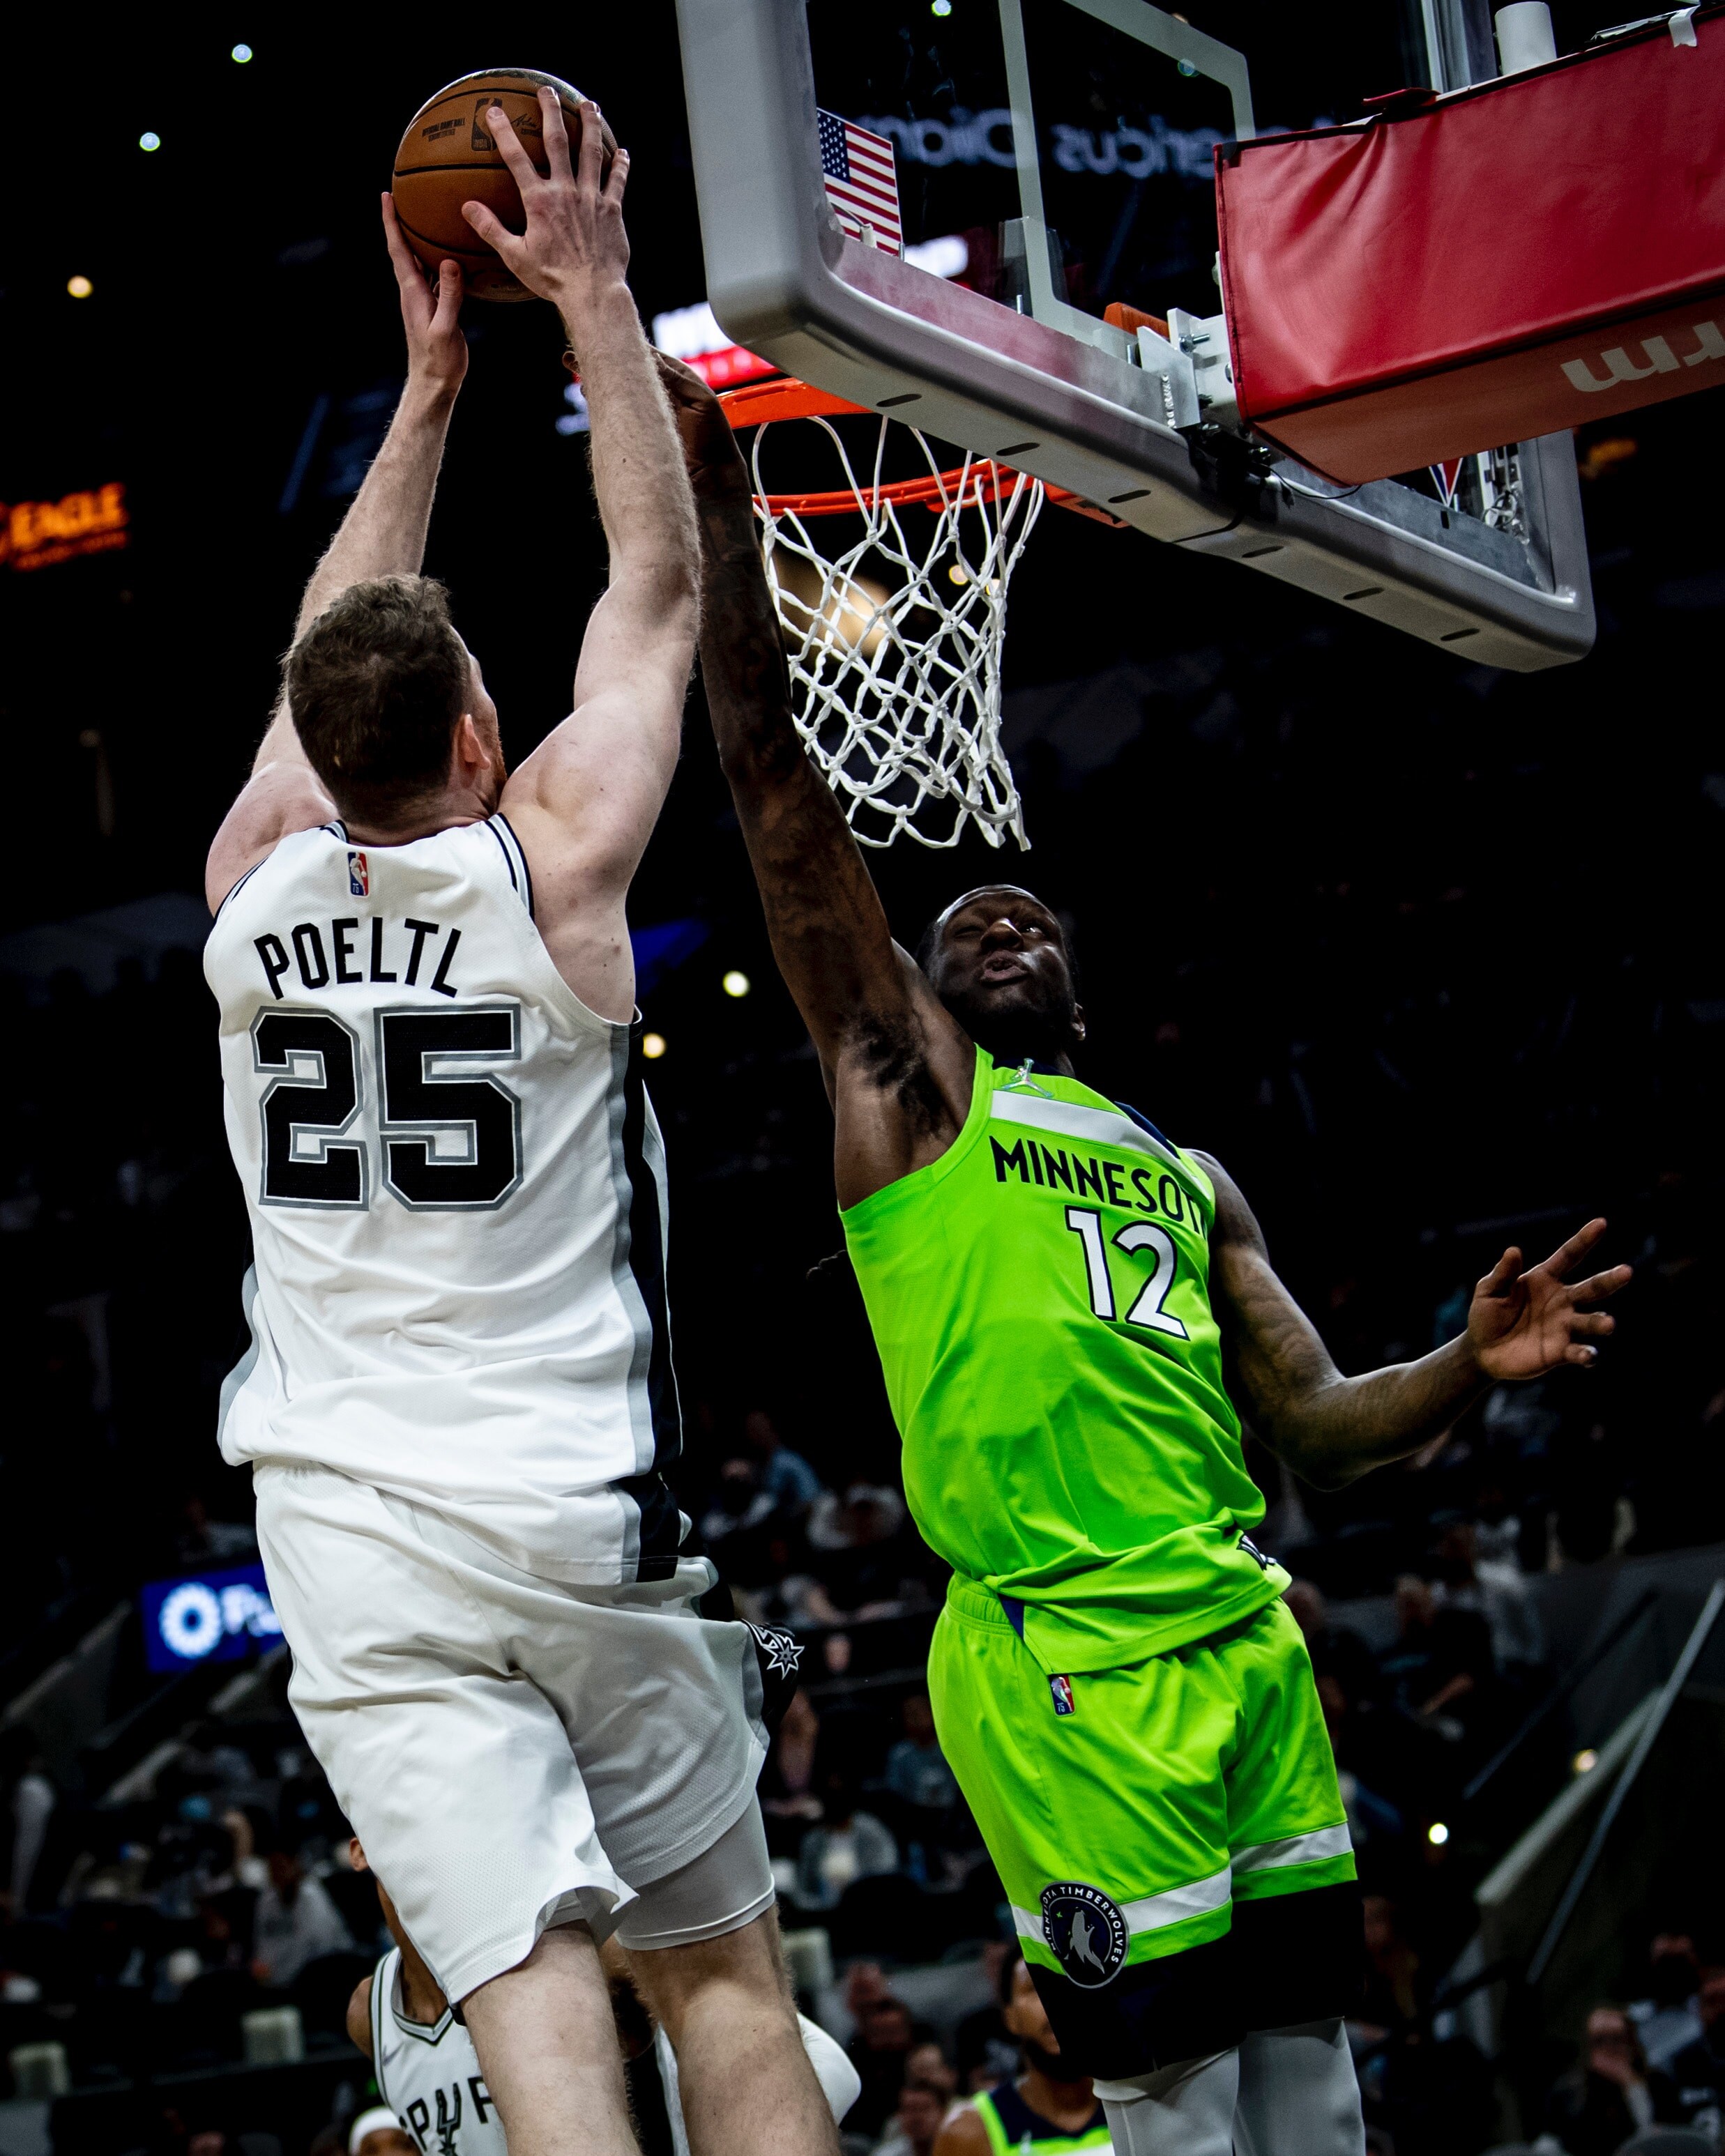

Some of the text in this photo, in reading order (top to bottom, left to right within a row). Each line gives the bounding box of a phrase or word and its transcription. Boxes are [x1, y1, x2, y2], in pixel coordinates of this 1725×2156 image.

[253, 916, 462, 1000] POELTL
[249, 1003, 524, 1212] 25
[1064, 1204, 1191, 1342] 12
[1059, 1886, 1125, 1964] TIMBERWOLVES
